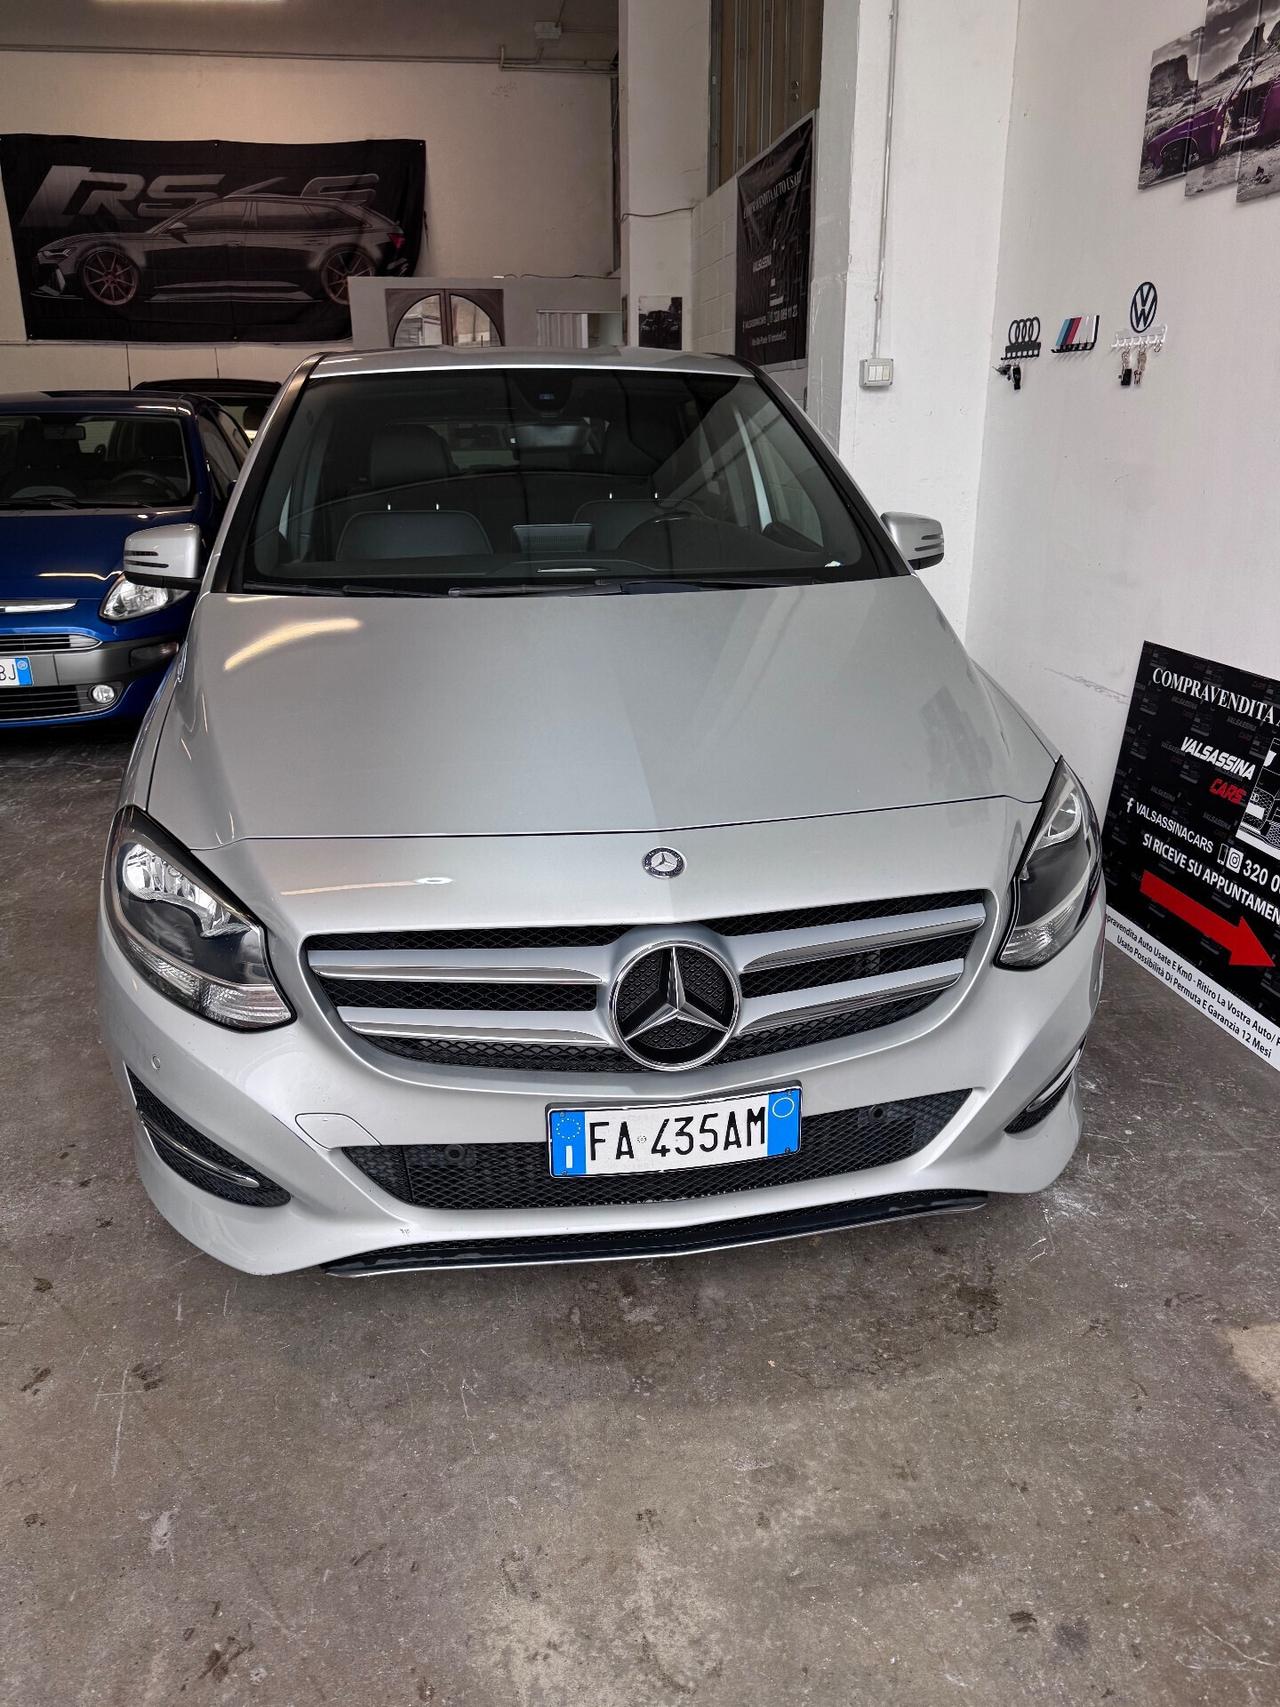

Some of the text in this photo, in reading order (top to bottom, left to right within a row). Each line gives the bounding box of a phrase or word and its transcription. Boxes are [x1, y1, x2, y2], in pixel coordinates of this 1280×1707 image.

[1152, 667, 1274, 722] COMPRAVENDITA
[1181, 737, 1256, 780] VALSASSINA
[1209, 778, 1248, 805] CARS
[1136, 802, 1214, 853] VALSASSINACARS
[1243, 859, 1268, 885] 320
[1271, 874, 1280, 894] 0
[1142, 833, 1153, 849] SI
[1153, 835, 1187, 874] RICEVE
[1186, 859, 1202, 877] SU
[1106, 914, 1138, 941] pravendita
[1137, 937, 1153, 953] Auto
[1154, 946, 1172, 966] Usate
[1172, 960, 1177, 970] E
[1176, 963, 1193, 982] Km0
[1197, 979, 1216, 1000] Ritiro
[1217, 992, 1226, 1006] La
[1227, 999, 1251, 1025] Vostra
[1252, 1020, 1276, 1043] Auto/
[1117, 935, 1134, 953] Usato
[1165, 971, 1173, 985] Di
[1173, 978, 1201, 1005] Permuta
[1201, 1000, 1207, 1010] E
[1207, 1004, 1240, 1035] Garanzia
[1241, 1030, 1251, 1041] 12
[1251, 1036, 1272, 1058] Mesi
[589, 1121, 635, 1161] FA
[651, 1106, 766, 1158] 435AM
